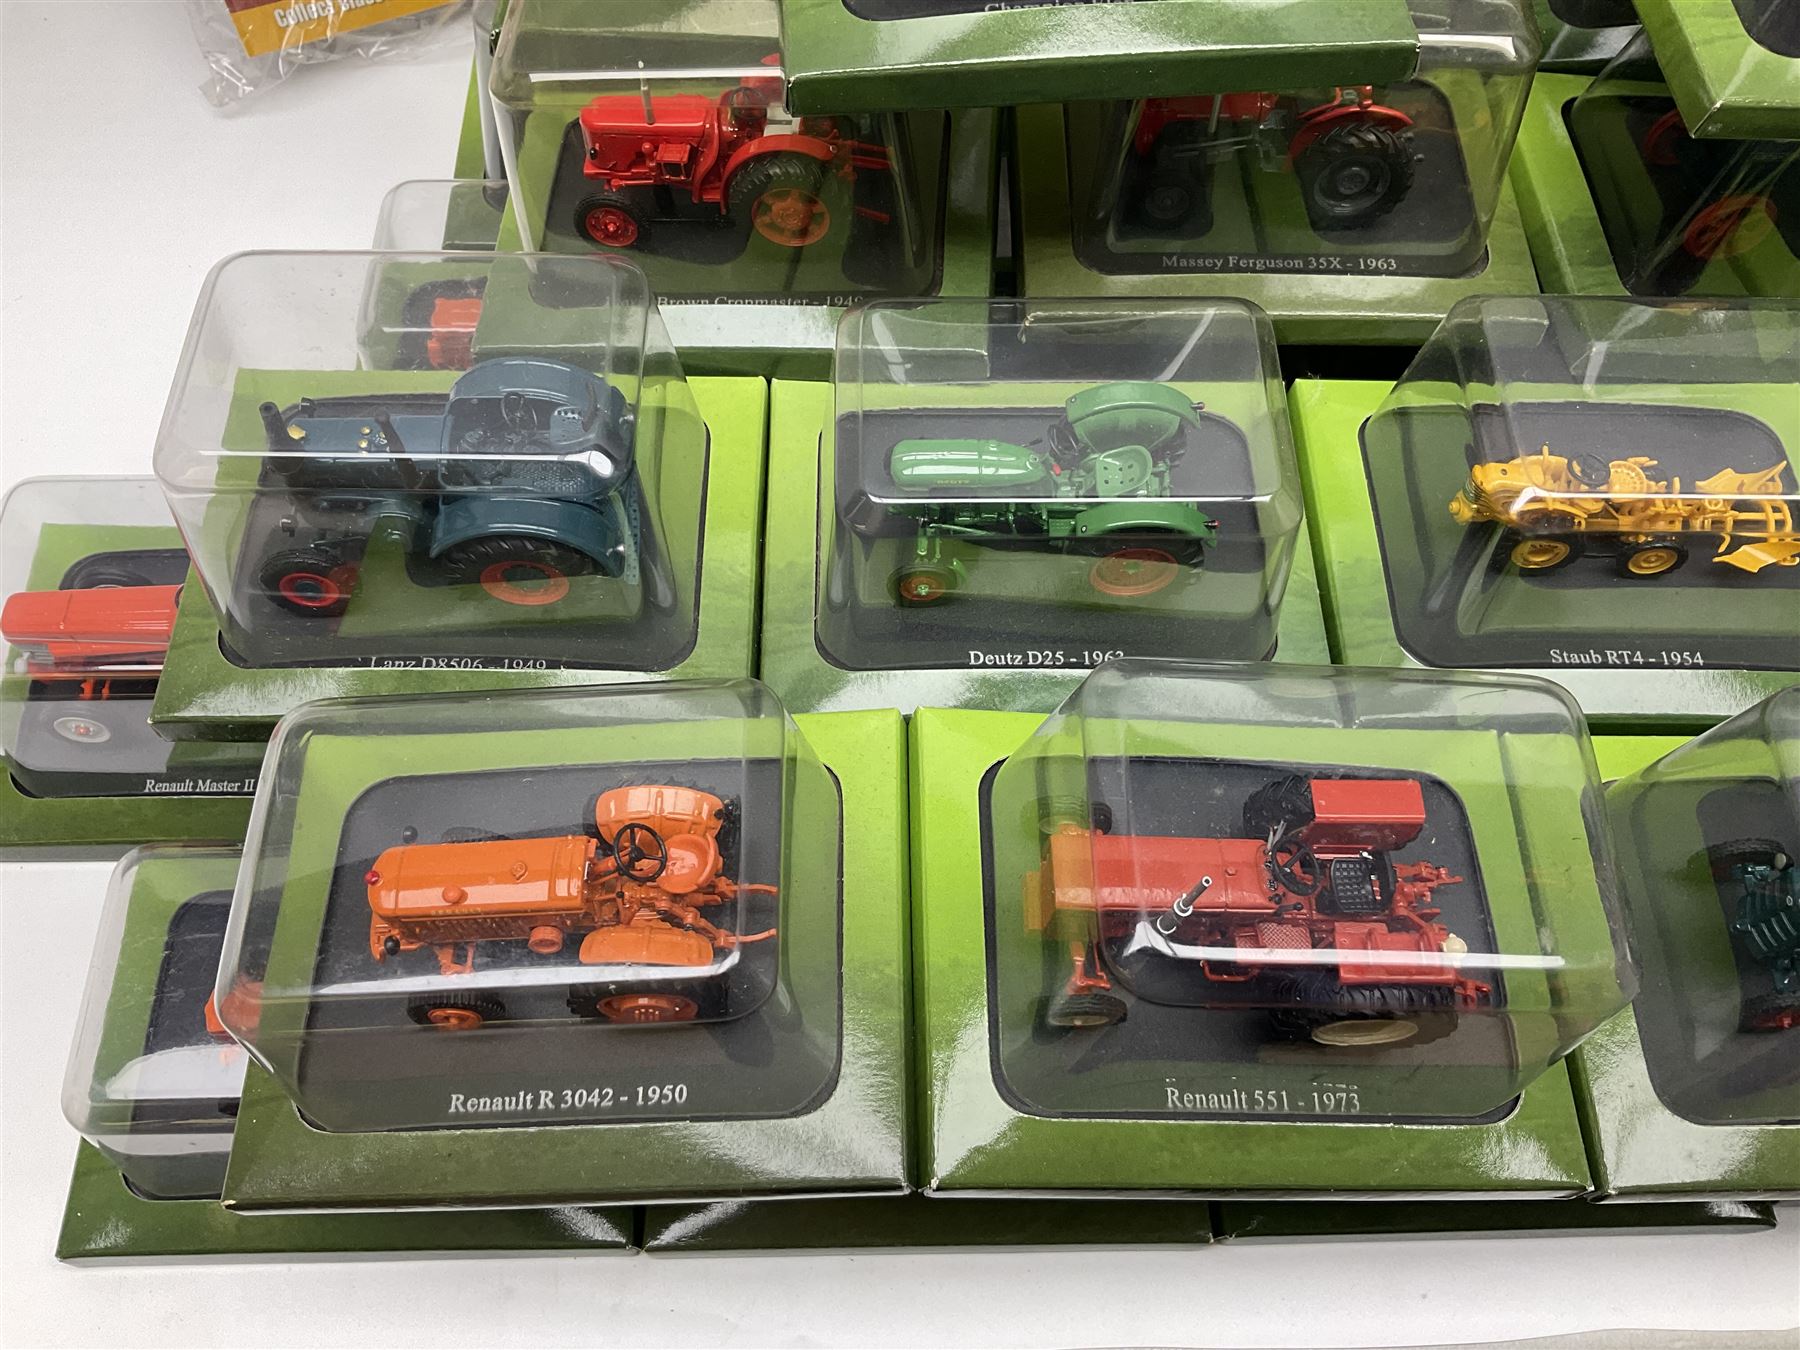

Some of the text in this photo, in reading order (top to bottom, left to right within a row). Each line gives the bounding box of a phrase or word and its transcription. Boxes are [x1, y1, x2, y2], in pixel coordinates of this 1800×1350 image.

[1162, 256, 1223, 270] Massey
[1228, 256, 1303, 270] Ferguson
[1308, 257, 1342, 269] 35X
[1359, 258, 1397, 270] 1963
[657, 296, 709, 305] Brown
[370, 656, 416, 668] Lanz
[421, 657, 484, 669] D8506
[503, 659, 547, 669] 1949
[968, 651, 1023, 665] Deutz
[1027, 651, 1064, 665] D25
[1550, 649, 1601, 664] Staub
[1605, 650, 1644, 665] RT4
[1661, 651, 1704, 666] 1954
[144, 779, 256, 792] Renault Master II
[449, 1091, 534, 1113] Renault
[538, 1090, 555, 1109] R
[561, 1088, 614, 1108] 3042
[636, 1084, 688, 1105] 1950
[1164, 1087, 1248, 1109] Renault
[1254, 1090, 1289, 1111] 551
[1312, 1091, 1360, 1112] 1973
